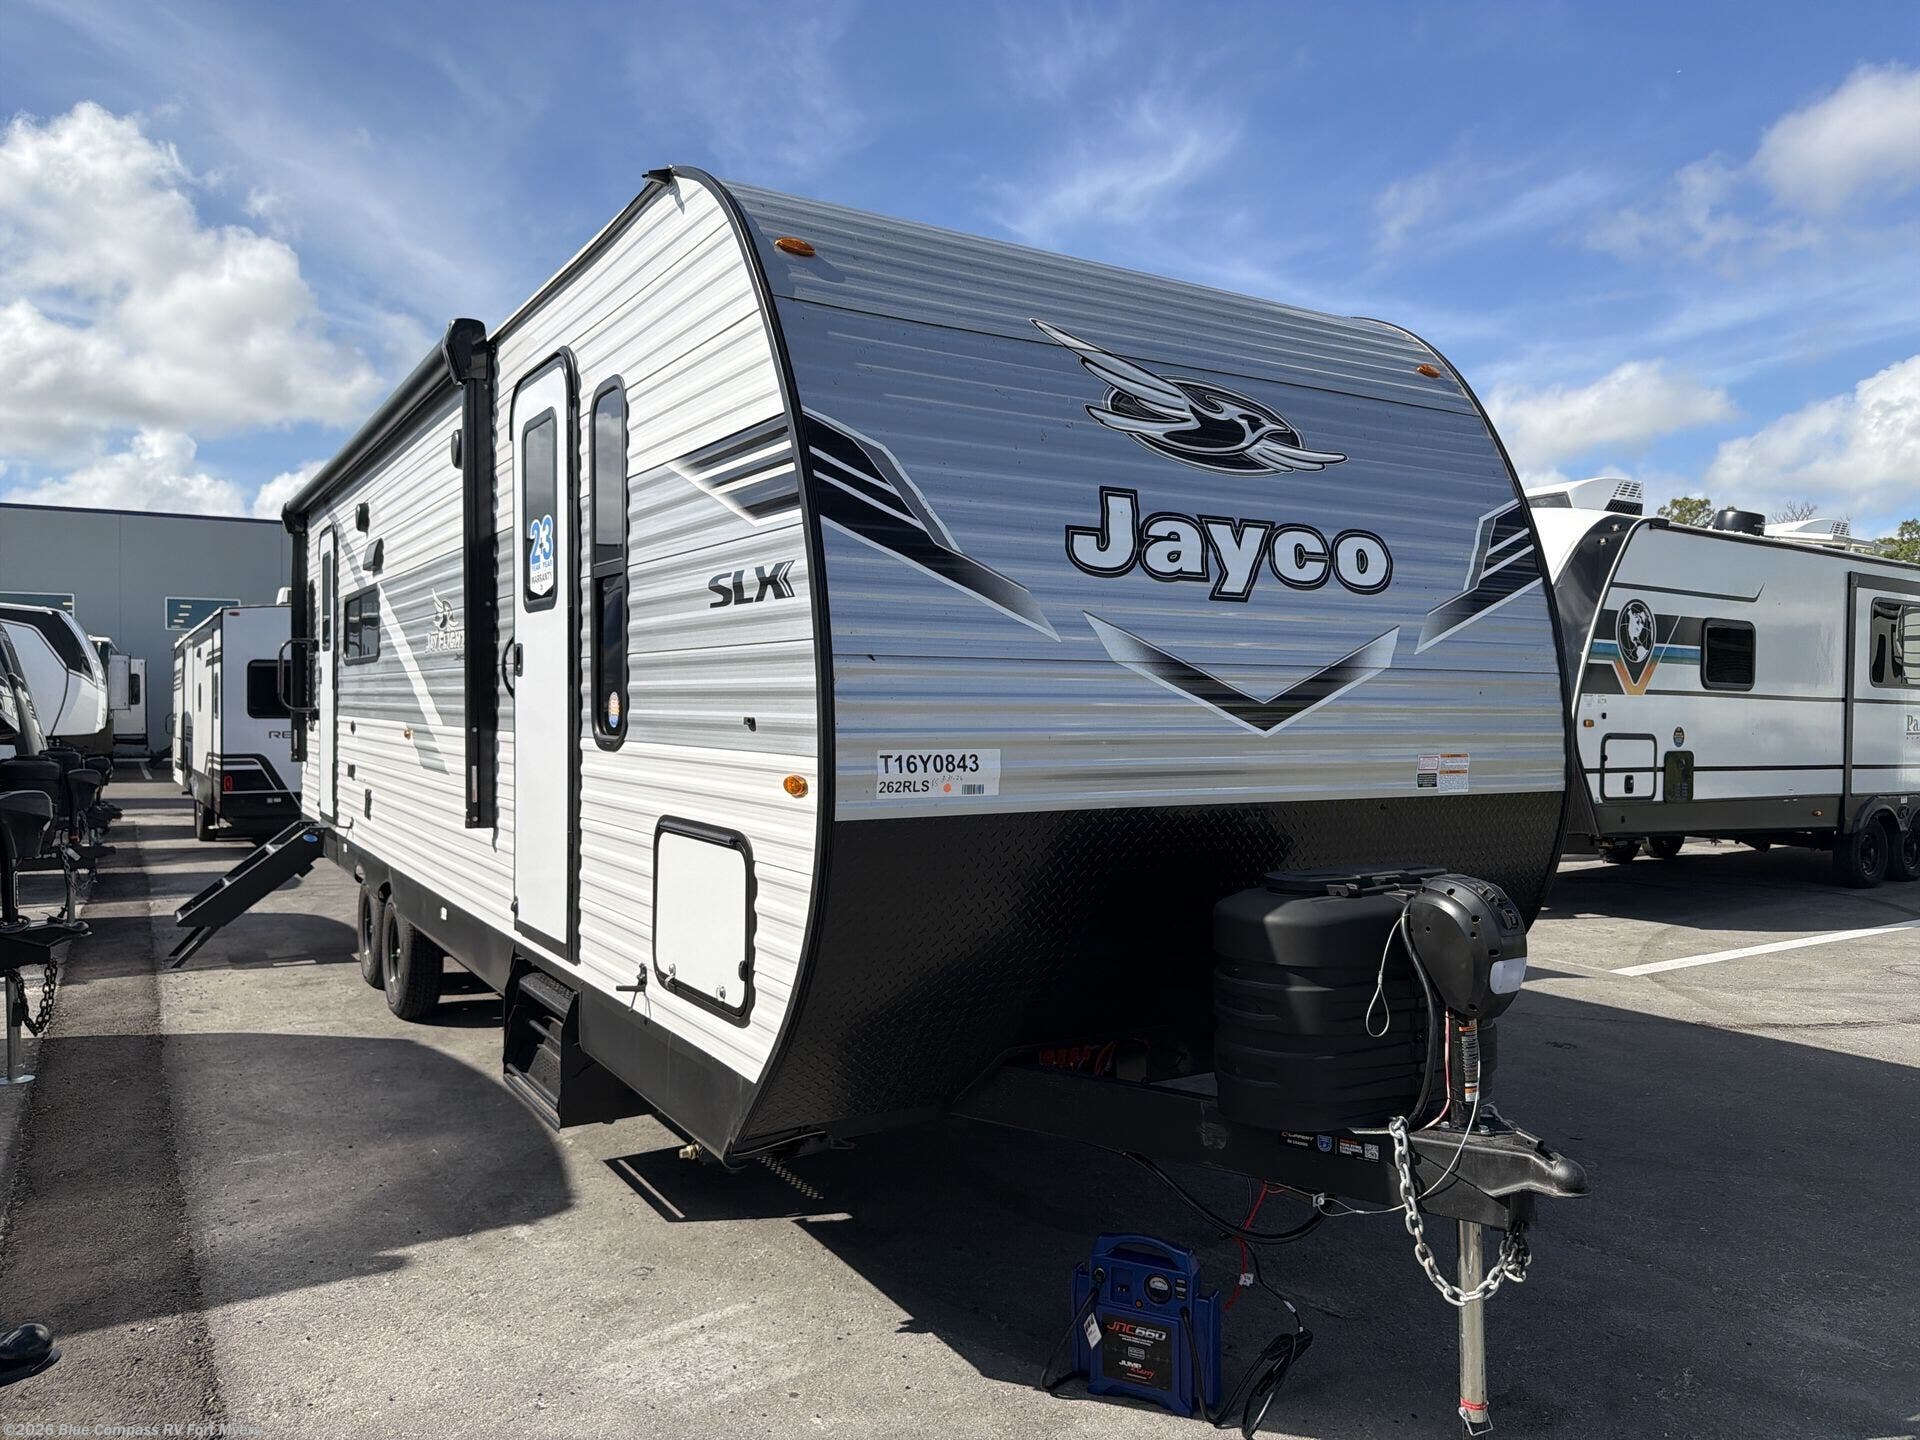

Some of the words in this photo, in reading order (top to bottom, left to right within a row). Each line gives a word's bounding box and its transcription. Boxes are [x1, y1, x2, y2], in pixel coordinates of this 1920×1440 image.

[1065, 486, 1394, 602] Jayco
[708, 560, 796, 608] SLX
[879, 753, 980, 774] T16Y0843
[878, 780, 930, 794] 262RLS
[1107, 1321, 1166, 1340] JNC660
